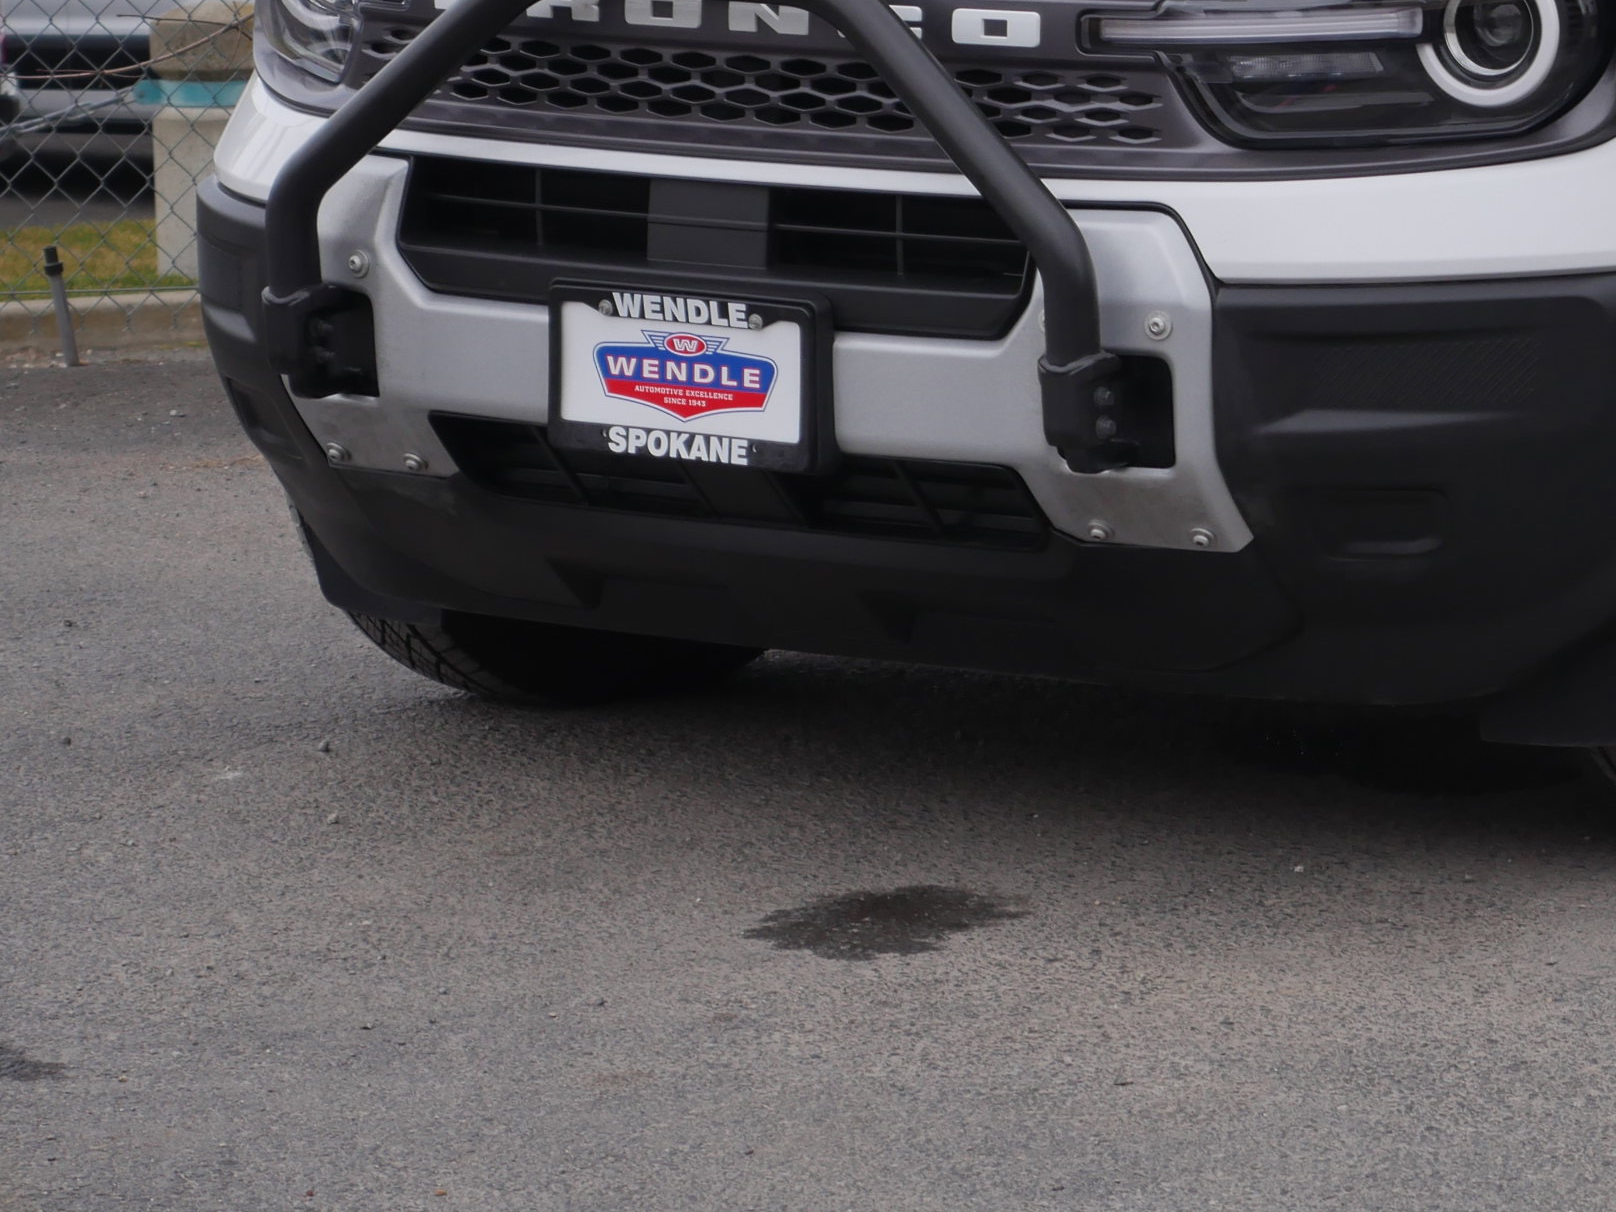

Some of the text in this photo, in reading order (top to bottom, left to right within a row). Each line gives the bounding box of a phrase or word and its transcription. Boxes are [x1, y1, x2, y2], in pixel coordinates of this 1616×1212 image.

[612, 292, 748, 329] WENDLE
[672, 338, 698, 353] W
[606, 355, 761, 389] WENDLE
[634, 385, 733, 401] AUTOMOTIVE EXCELLENCE
[663, 396, 686, 405] SINCE
[608, 426, 748, 466] SPOKANE
